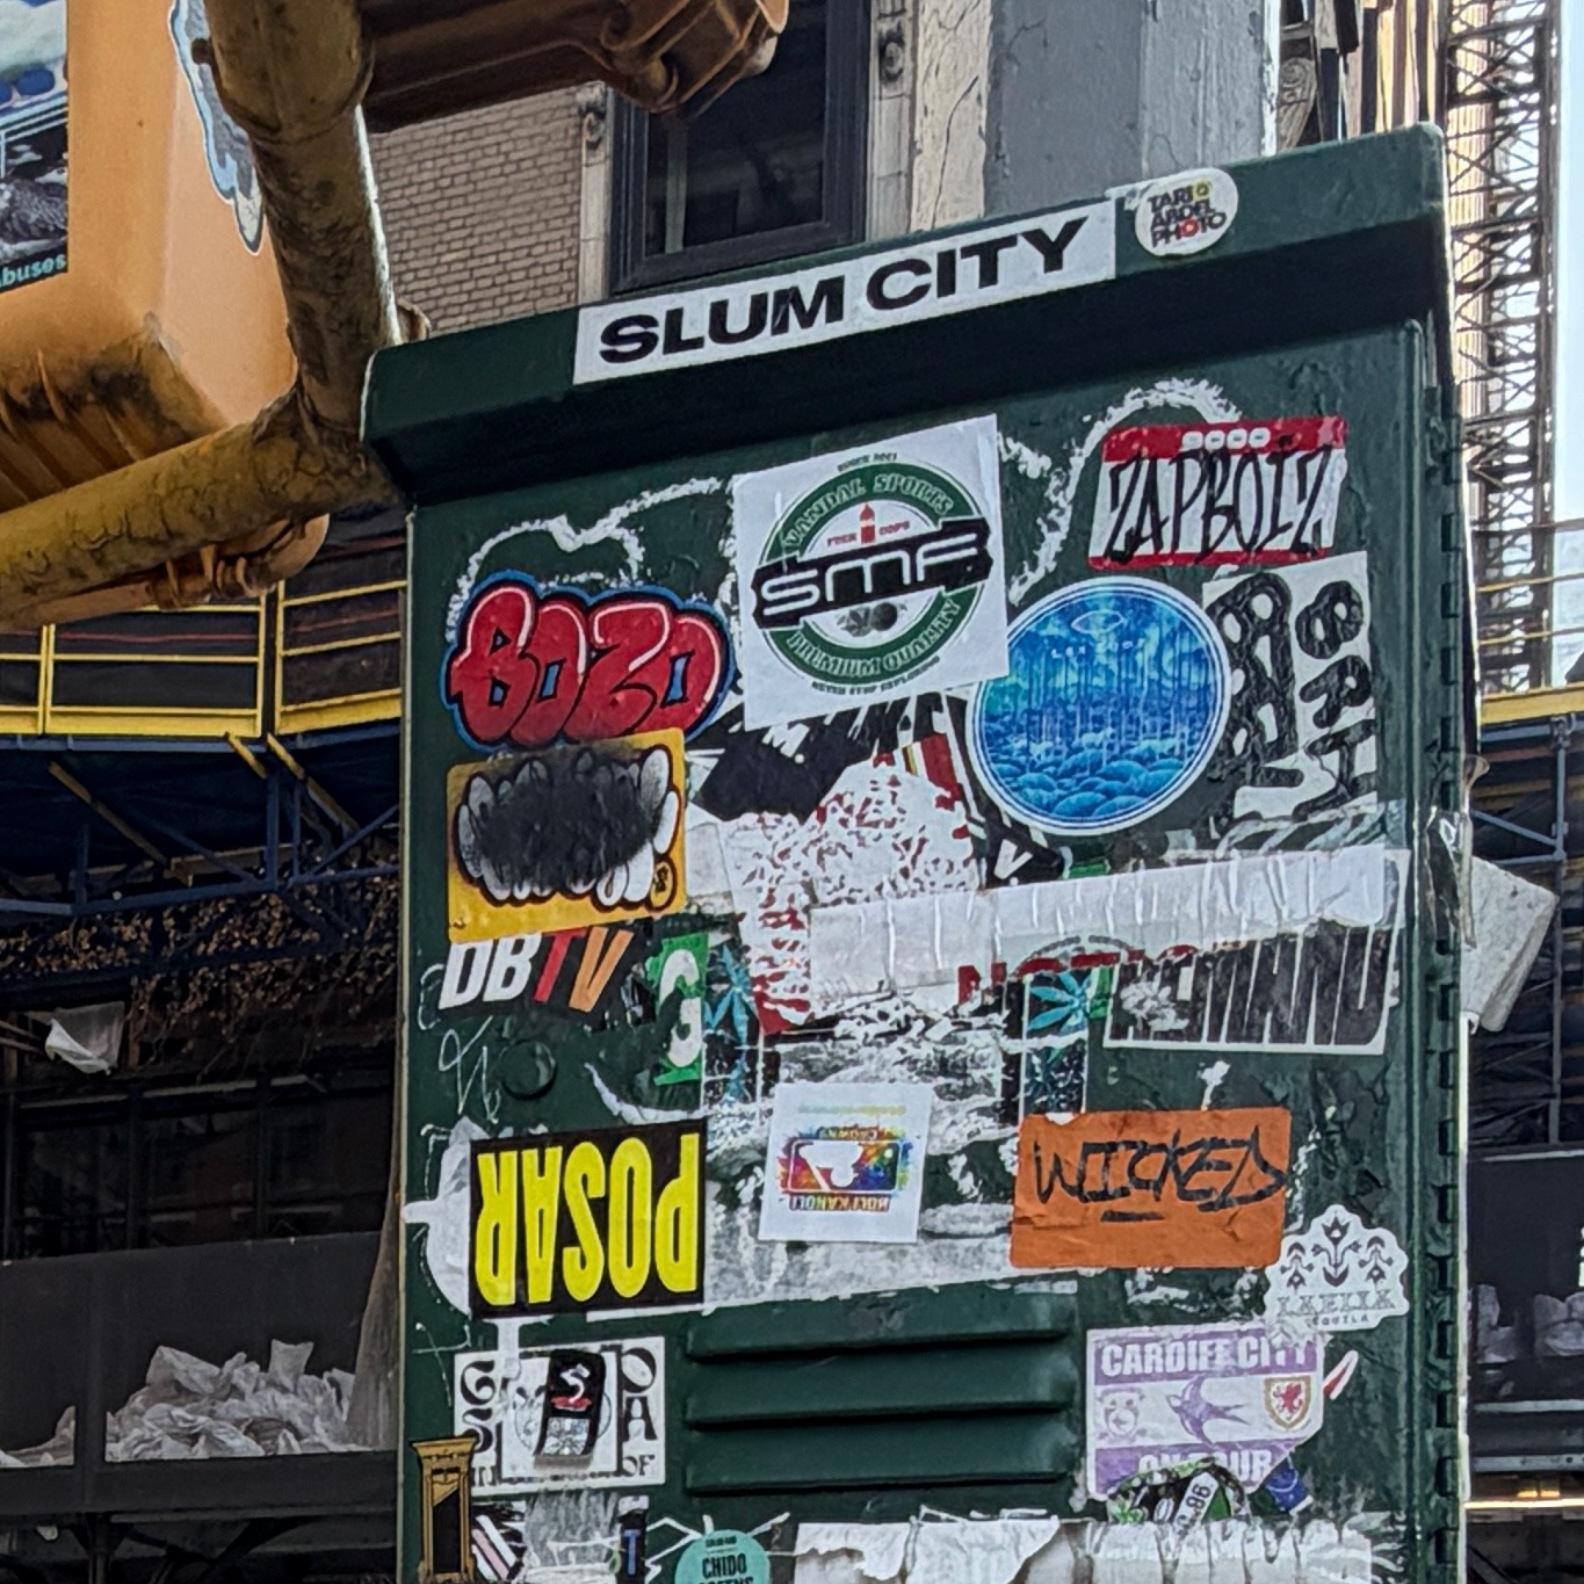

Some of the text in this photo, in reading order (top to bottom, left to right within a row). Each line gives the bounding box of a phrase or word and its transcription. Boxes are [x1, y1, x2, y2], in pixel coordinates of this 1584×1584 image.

[1151, 212, 1227, 249] PHOTO
[599, 216, 1088, 364] SLUM CITY
[873, 473, 954, 515] SPORTS
[787, 599, 961, 678] PREMIUM QUALITY
[437, 924, 634, 1013] DBTV
[1034, 1127, 1286, 1212] WICKED
[472, 1130, 701, 1307] POSAR
[1101, 1338, 1233, 1377] CARDIFF
[702, 1553, 748, 1580] CHIDO
